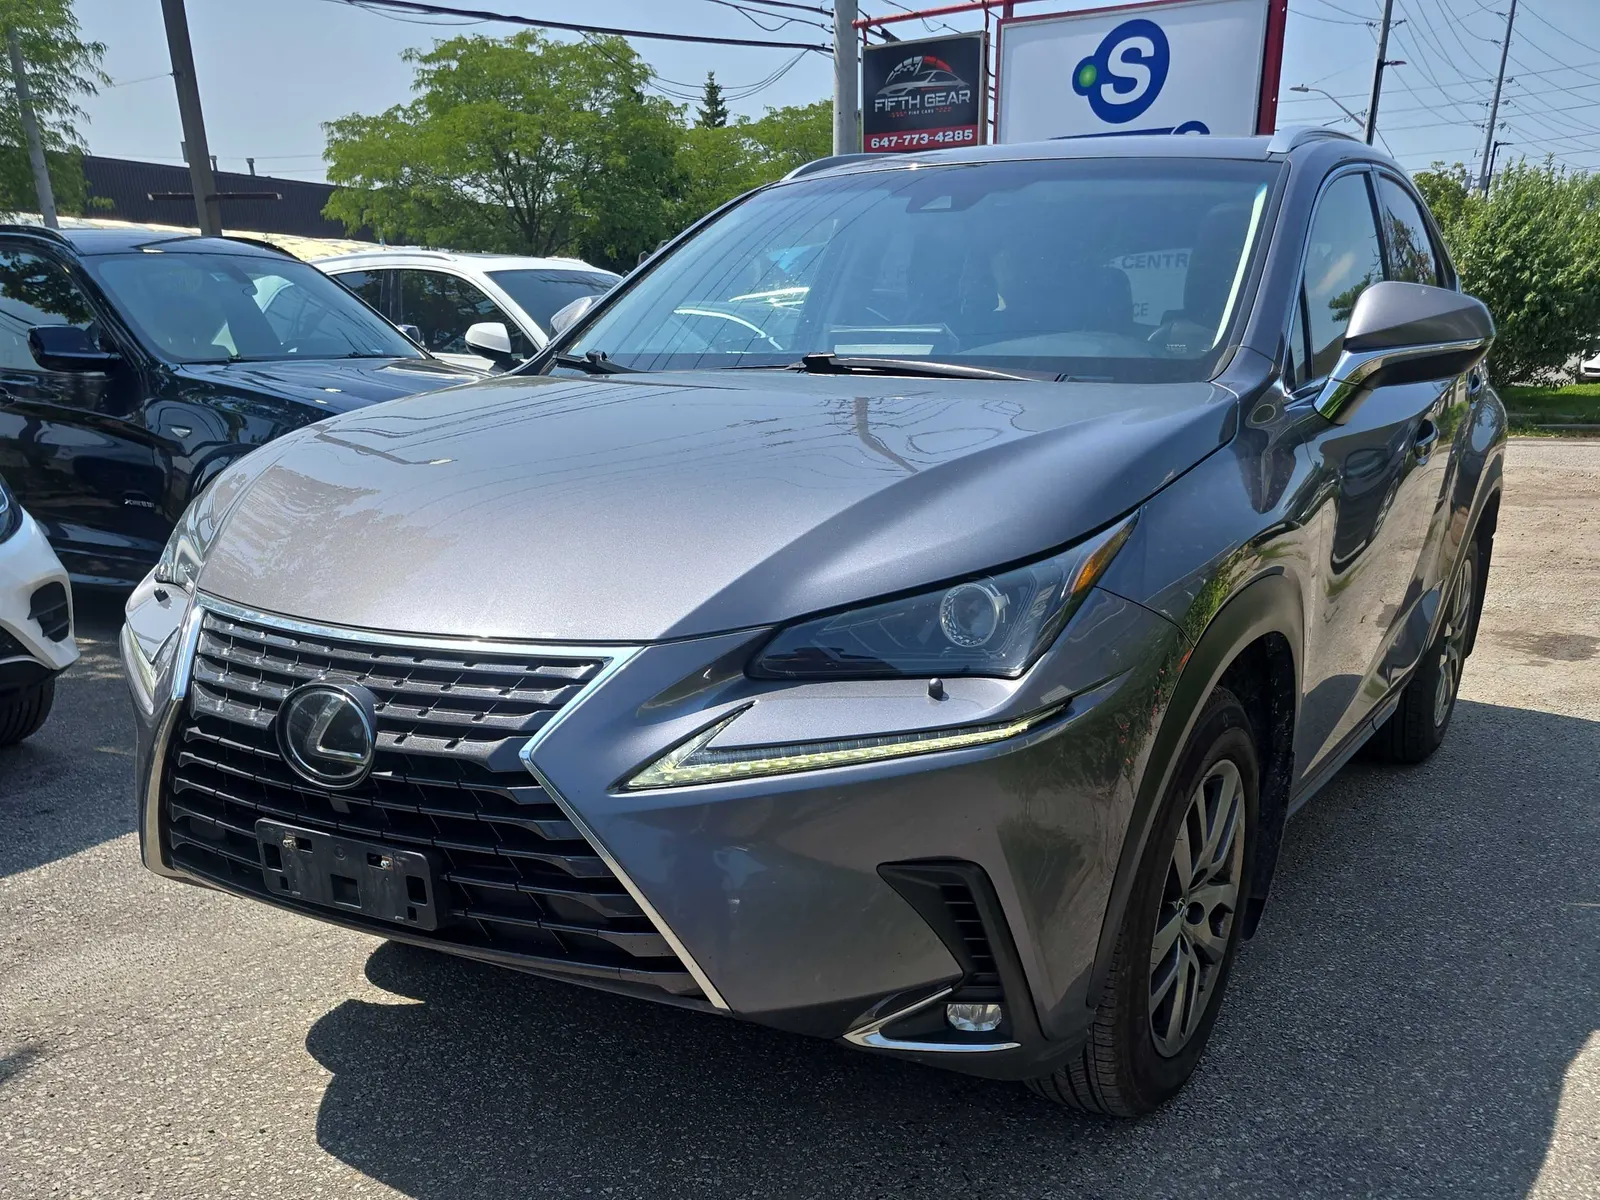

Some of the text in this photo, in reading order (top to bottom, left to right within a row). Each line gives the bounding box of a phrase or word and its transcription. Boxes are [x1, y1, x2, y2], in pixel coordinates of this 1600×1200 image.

[1101, 36, 1155, 105] S
[874, 89, 971, 113] FIFTH GEAR
[870, 129, 973, 149] 647-773-4285
[1121, 253, 1188, 270] CENTR
[1133, 302, 1150, 317] CE
